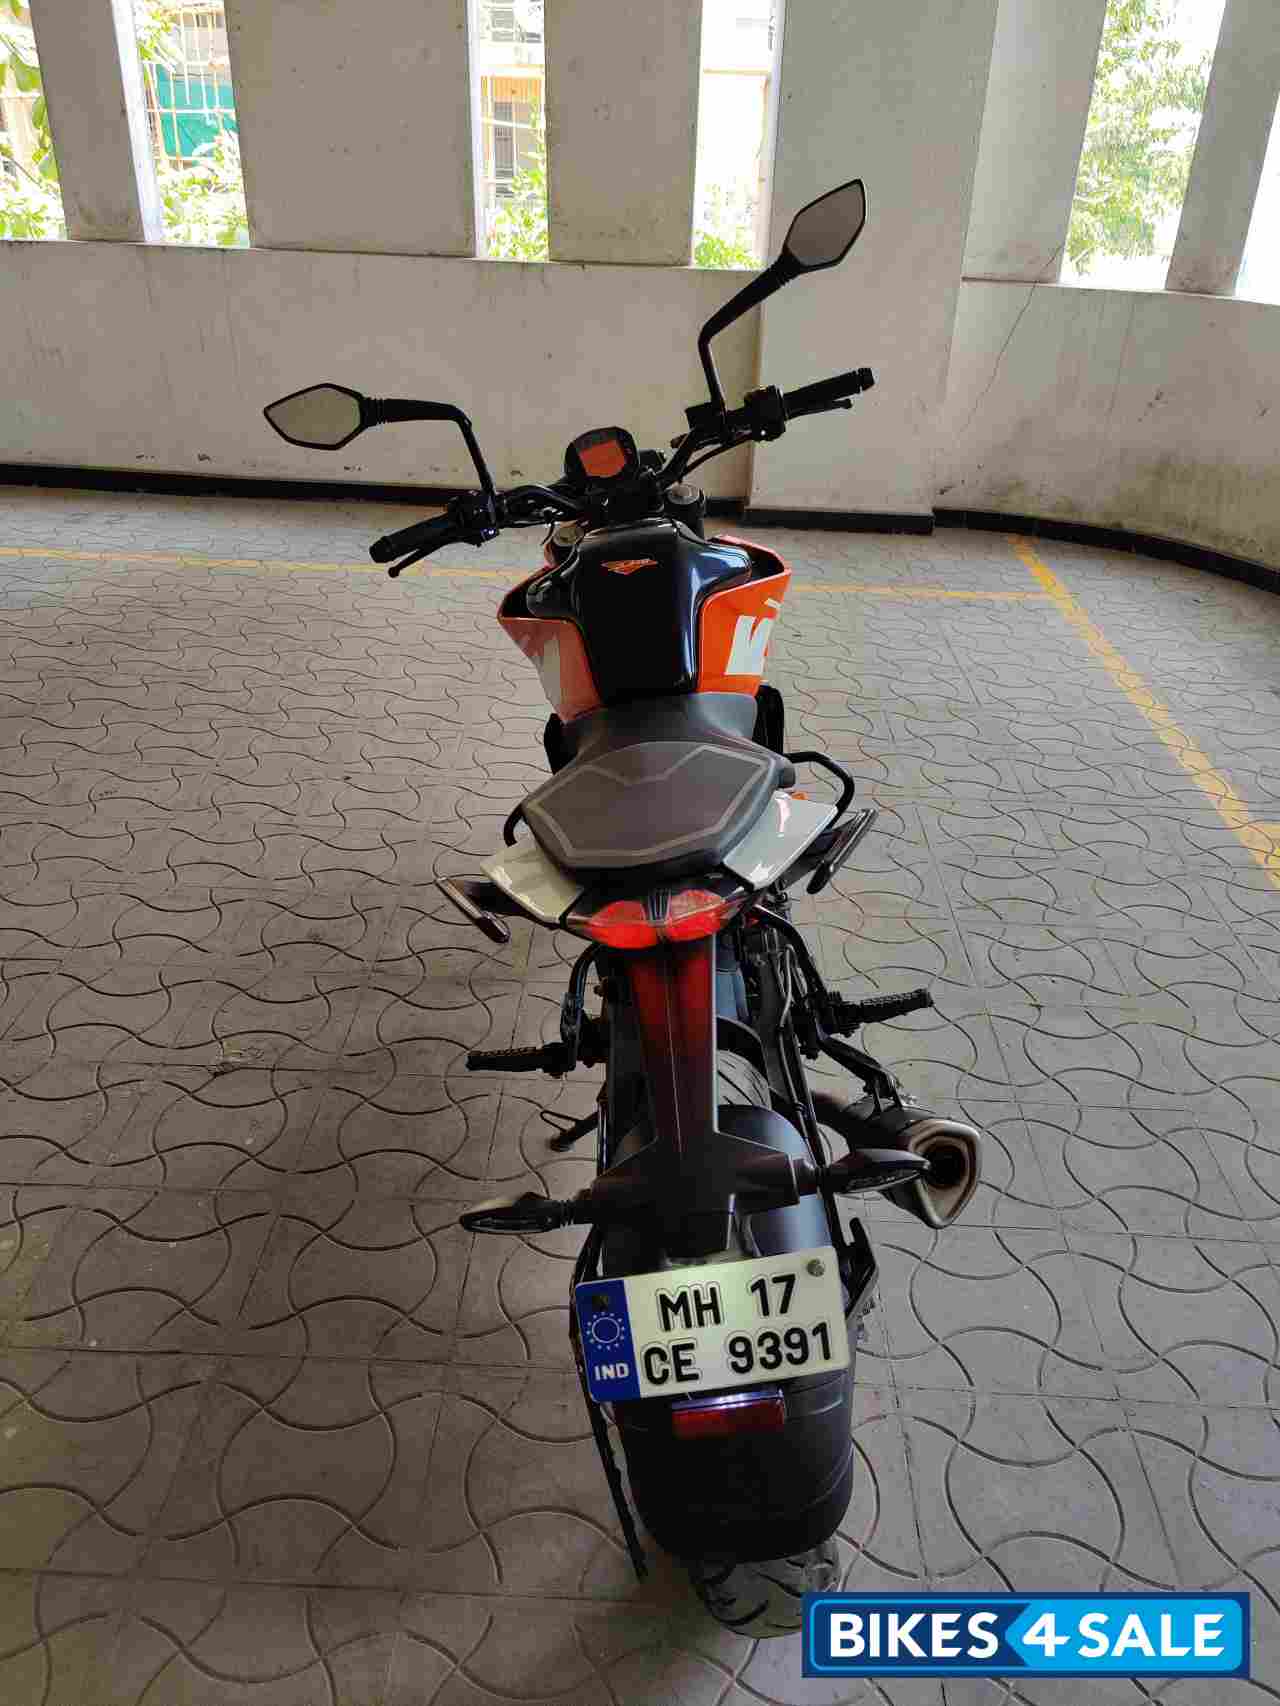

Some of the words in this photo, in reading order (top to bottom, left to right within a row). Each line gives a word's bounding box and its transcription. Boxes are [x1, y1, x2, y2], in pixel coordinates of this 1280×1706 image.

[658, 1286, 722, 1332] MH
[750, 1273, 797, 1318] 17
[594, 1362, 630, 1380] IND
[643, 1342, 700, 1386] CE
[728, 1321, 832, 1375] 9391
